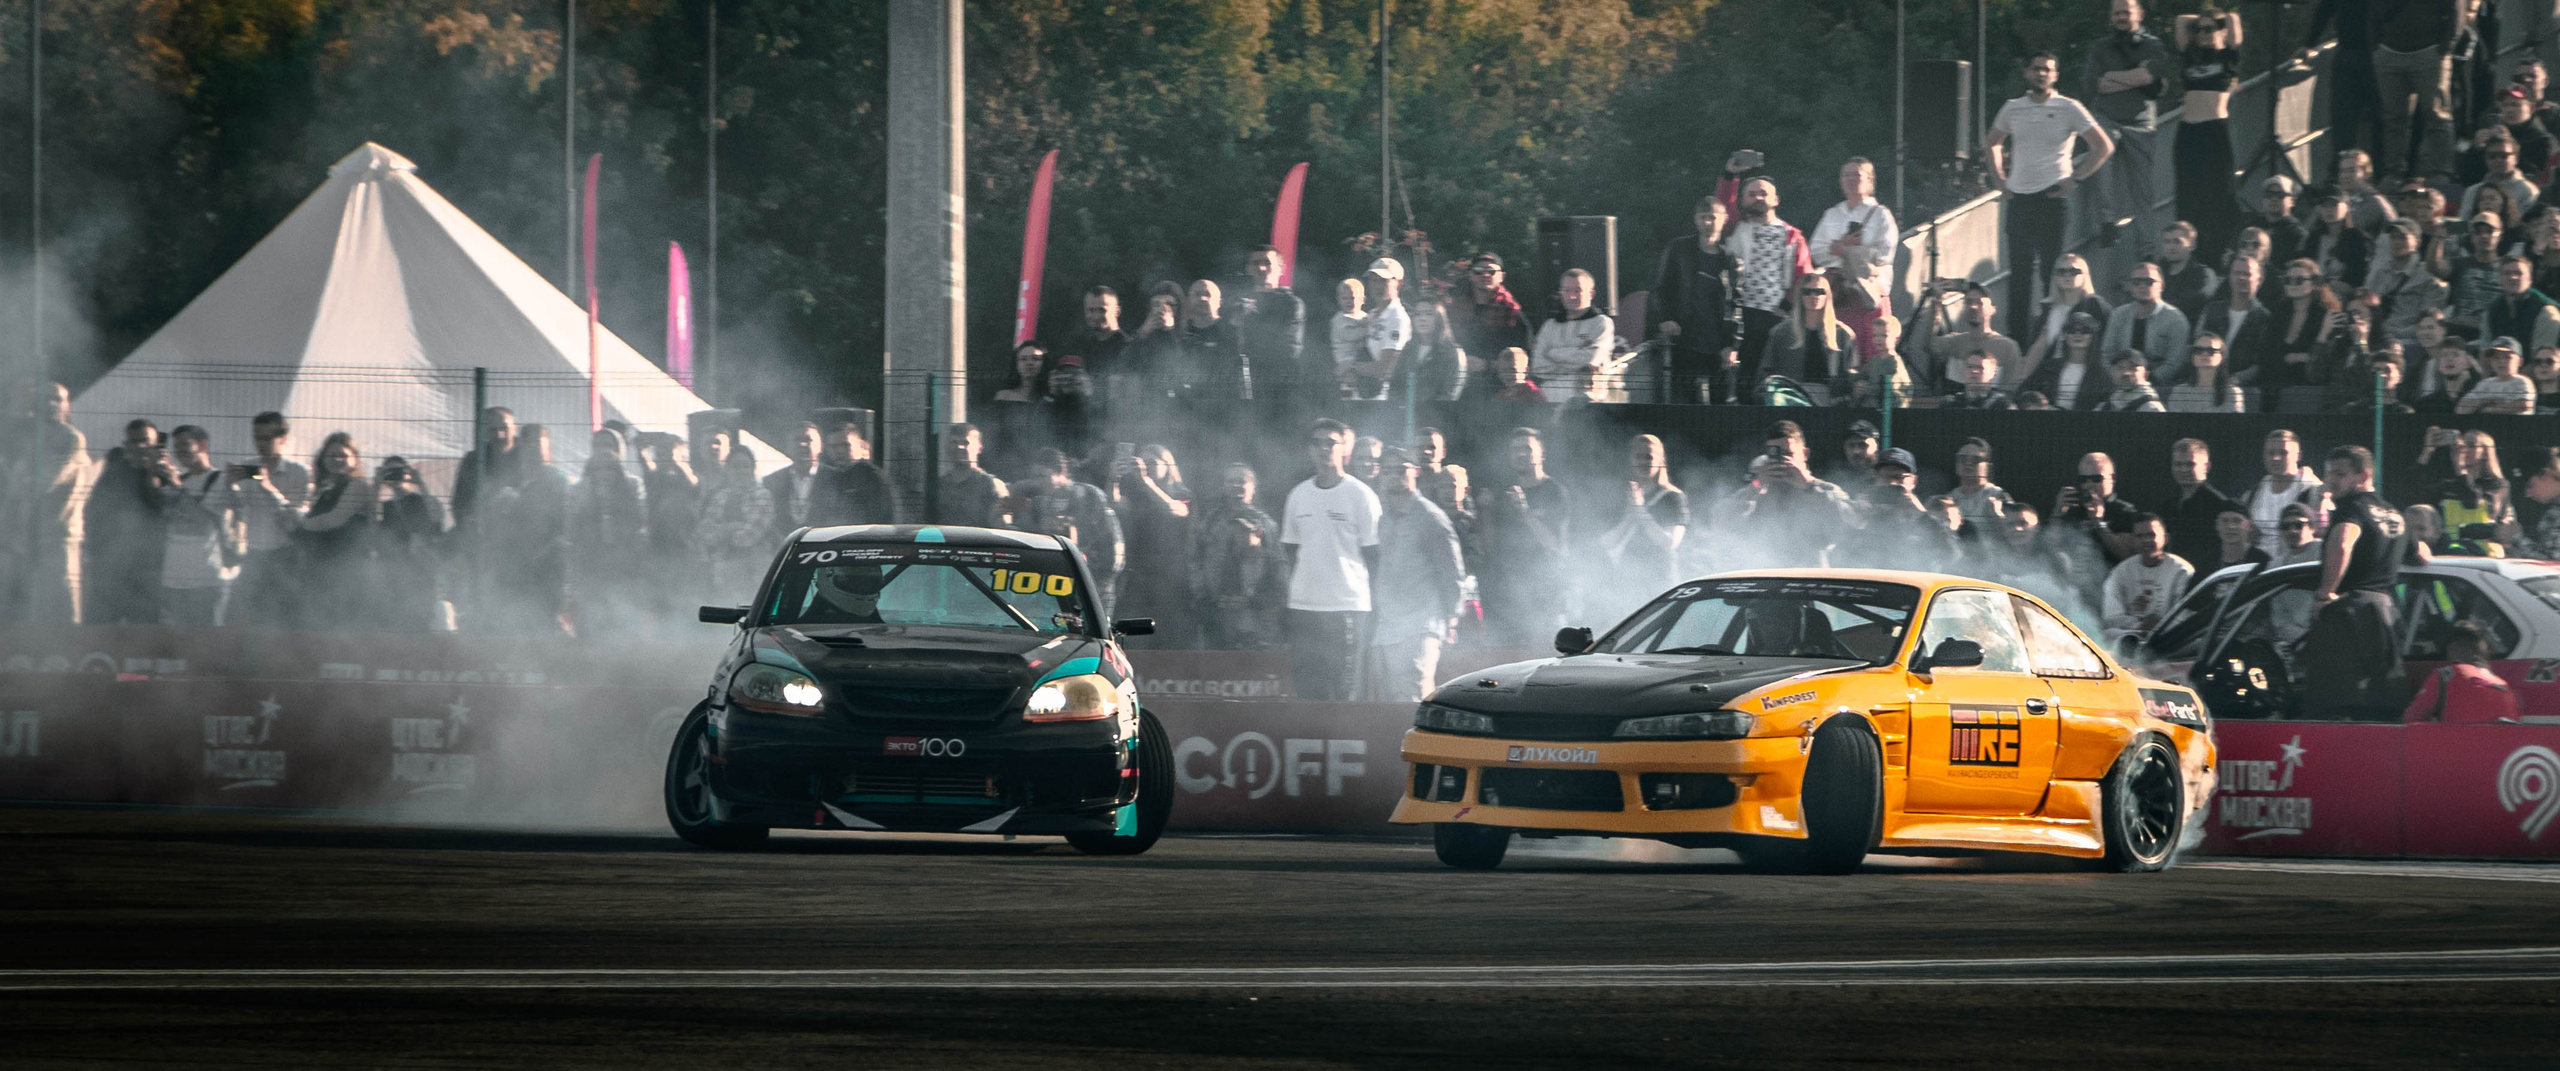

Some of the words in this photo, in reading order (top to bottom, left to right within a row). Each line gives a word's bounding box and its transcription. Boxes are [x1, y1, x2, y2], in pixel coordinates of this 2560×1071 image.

[798, 550, 838, 564] 70
[992, 568, 1074, 597] 100
[1668, 586, 1701, 600] 19
[1761, 691, 1817, 710] KINFOREST
[1523, 746, 1598, 764] ЛУКОЙЛ
[2220, 760, 2277, 793] ЦТВС
[2219, 796, 2312, 829] МОСКВА
